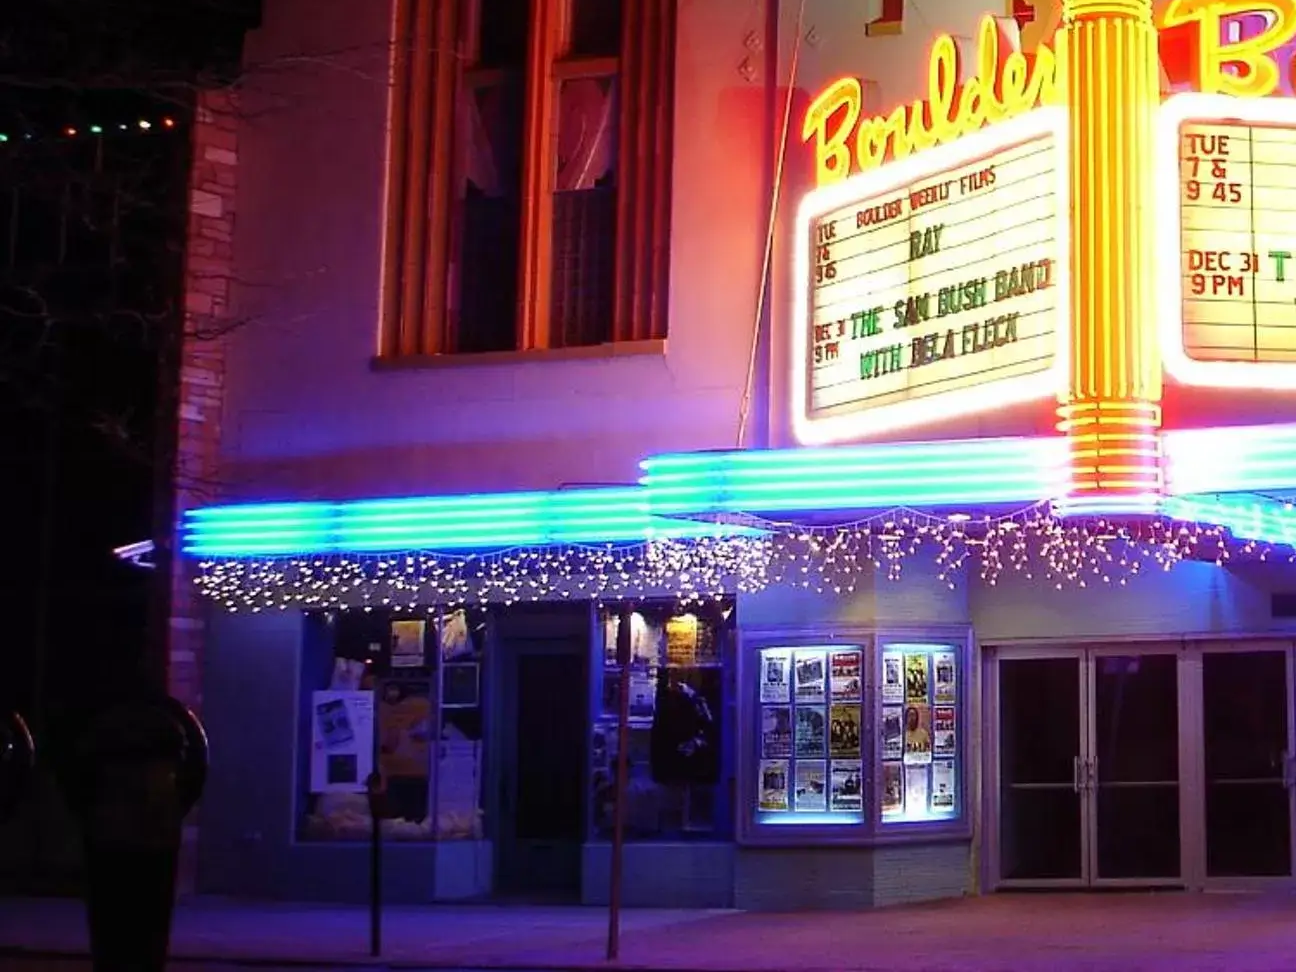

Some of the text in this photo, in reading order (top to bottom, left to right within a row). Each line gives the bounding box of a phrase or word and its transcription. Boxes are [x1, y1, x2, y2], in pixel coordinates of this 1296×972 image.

[803, 15, 1058, 187] Boulder
[1185, 134, 1230, 156] TUE
[1185, 157, 1227, 178] 7 &
[818, 220, 838, 244] TUE
[960, 166, 996, 195] FILMS
[1187, 180, 1242, 203] 9 45
[909, 223, 945, 261] RAY
[1188, 250, 1231, 271] DEC
[851, 258, 1051, 340] THE SAM BUSH BAND
[1191, 275, 1244, 296] 9 PM
[860, 311, 1019, 380] WITH BELA FLECK
